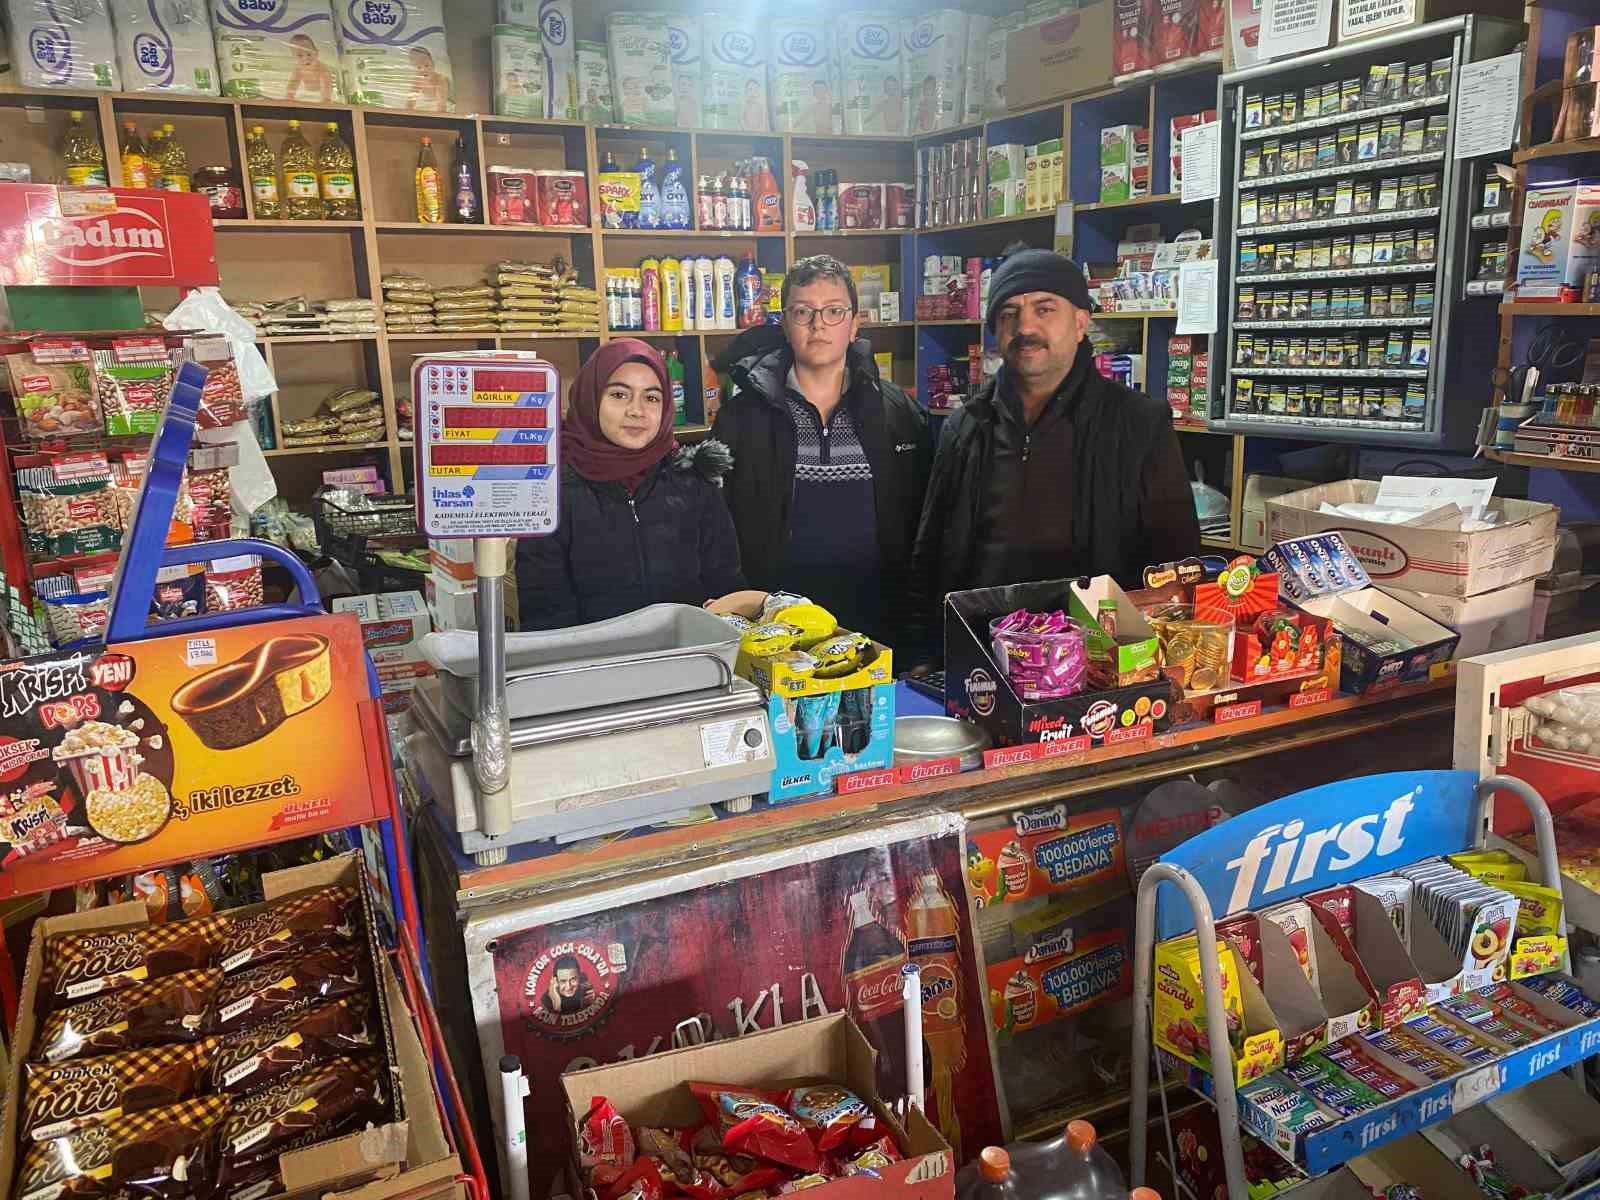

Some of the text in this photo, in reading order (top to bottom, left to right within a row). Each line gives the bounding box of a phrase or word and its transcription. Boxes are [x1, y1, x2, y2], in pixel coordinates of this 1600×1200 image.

[362, 12, 397, 26] Baby
[476, 392, 513, 402] AĞIRLIK
[445, 429, 472, 438] FİYAT
[431, 466, 544, 476] TUTAR TL
[432, 498, 474, 509] Tarsan
[40, 694, 101, 729] POPS
[1028, 716, 1066, 733] Mixed
[1039, 724, 1074, 743] Fruit
[992, 750, 1032, 765] ÜLKER
[911, 763, 954, 779] ÜLKER
[781, 773, 811, 789] ÜLKER
[847, 773, 894, 790] ÜLKER
[223, 775, 302, 808] lezzet.
[1017, 812, 1064, 832] Danino
[1226, 788, 1416, 915] first
[1055, 851, 1110, 878] BEDAVA
[80, 931, 137, 949] Dankek
[1028, 935, 1068, 959] Danino
[55, 943, 144, 996] pöti
[1063, 969, 1119, 1003] BEDAVA
[1529, 1043, 1562, 1076] first
[50, 1063, 114, 1082] Dankek
[1255, 1087, 1284, 1106] Nazar
[1271, 1095, 1300, 1117] Nazar
[21, 1076, 119, 1142] pöti
[1418, 1093, 1452, 1125] firs
[1360, 1111, 1398, 1149] first
